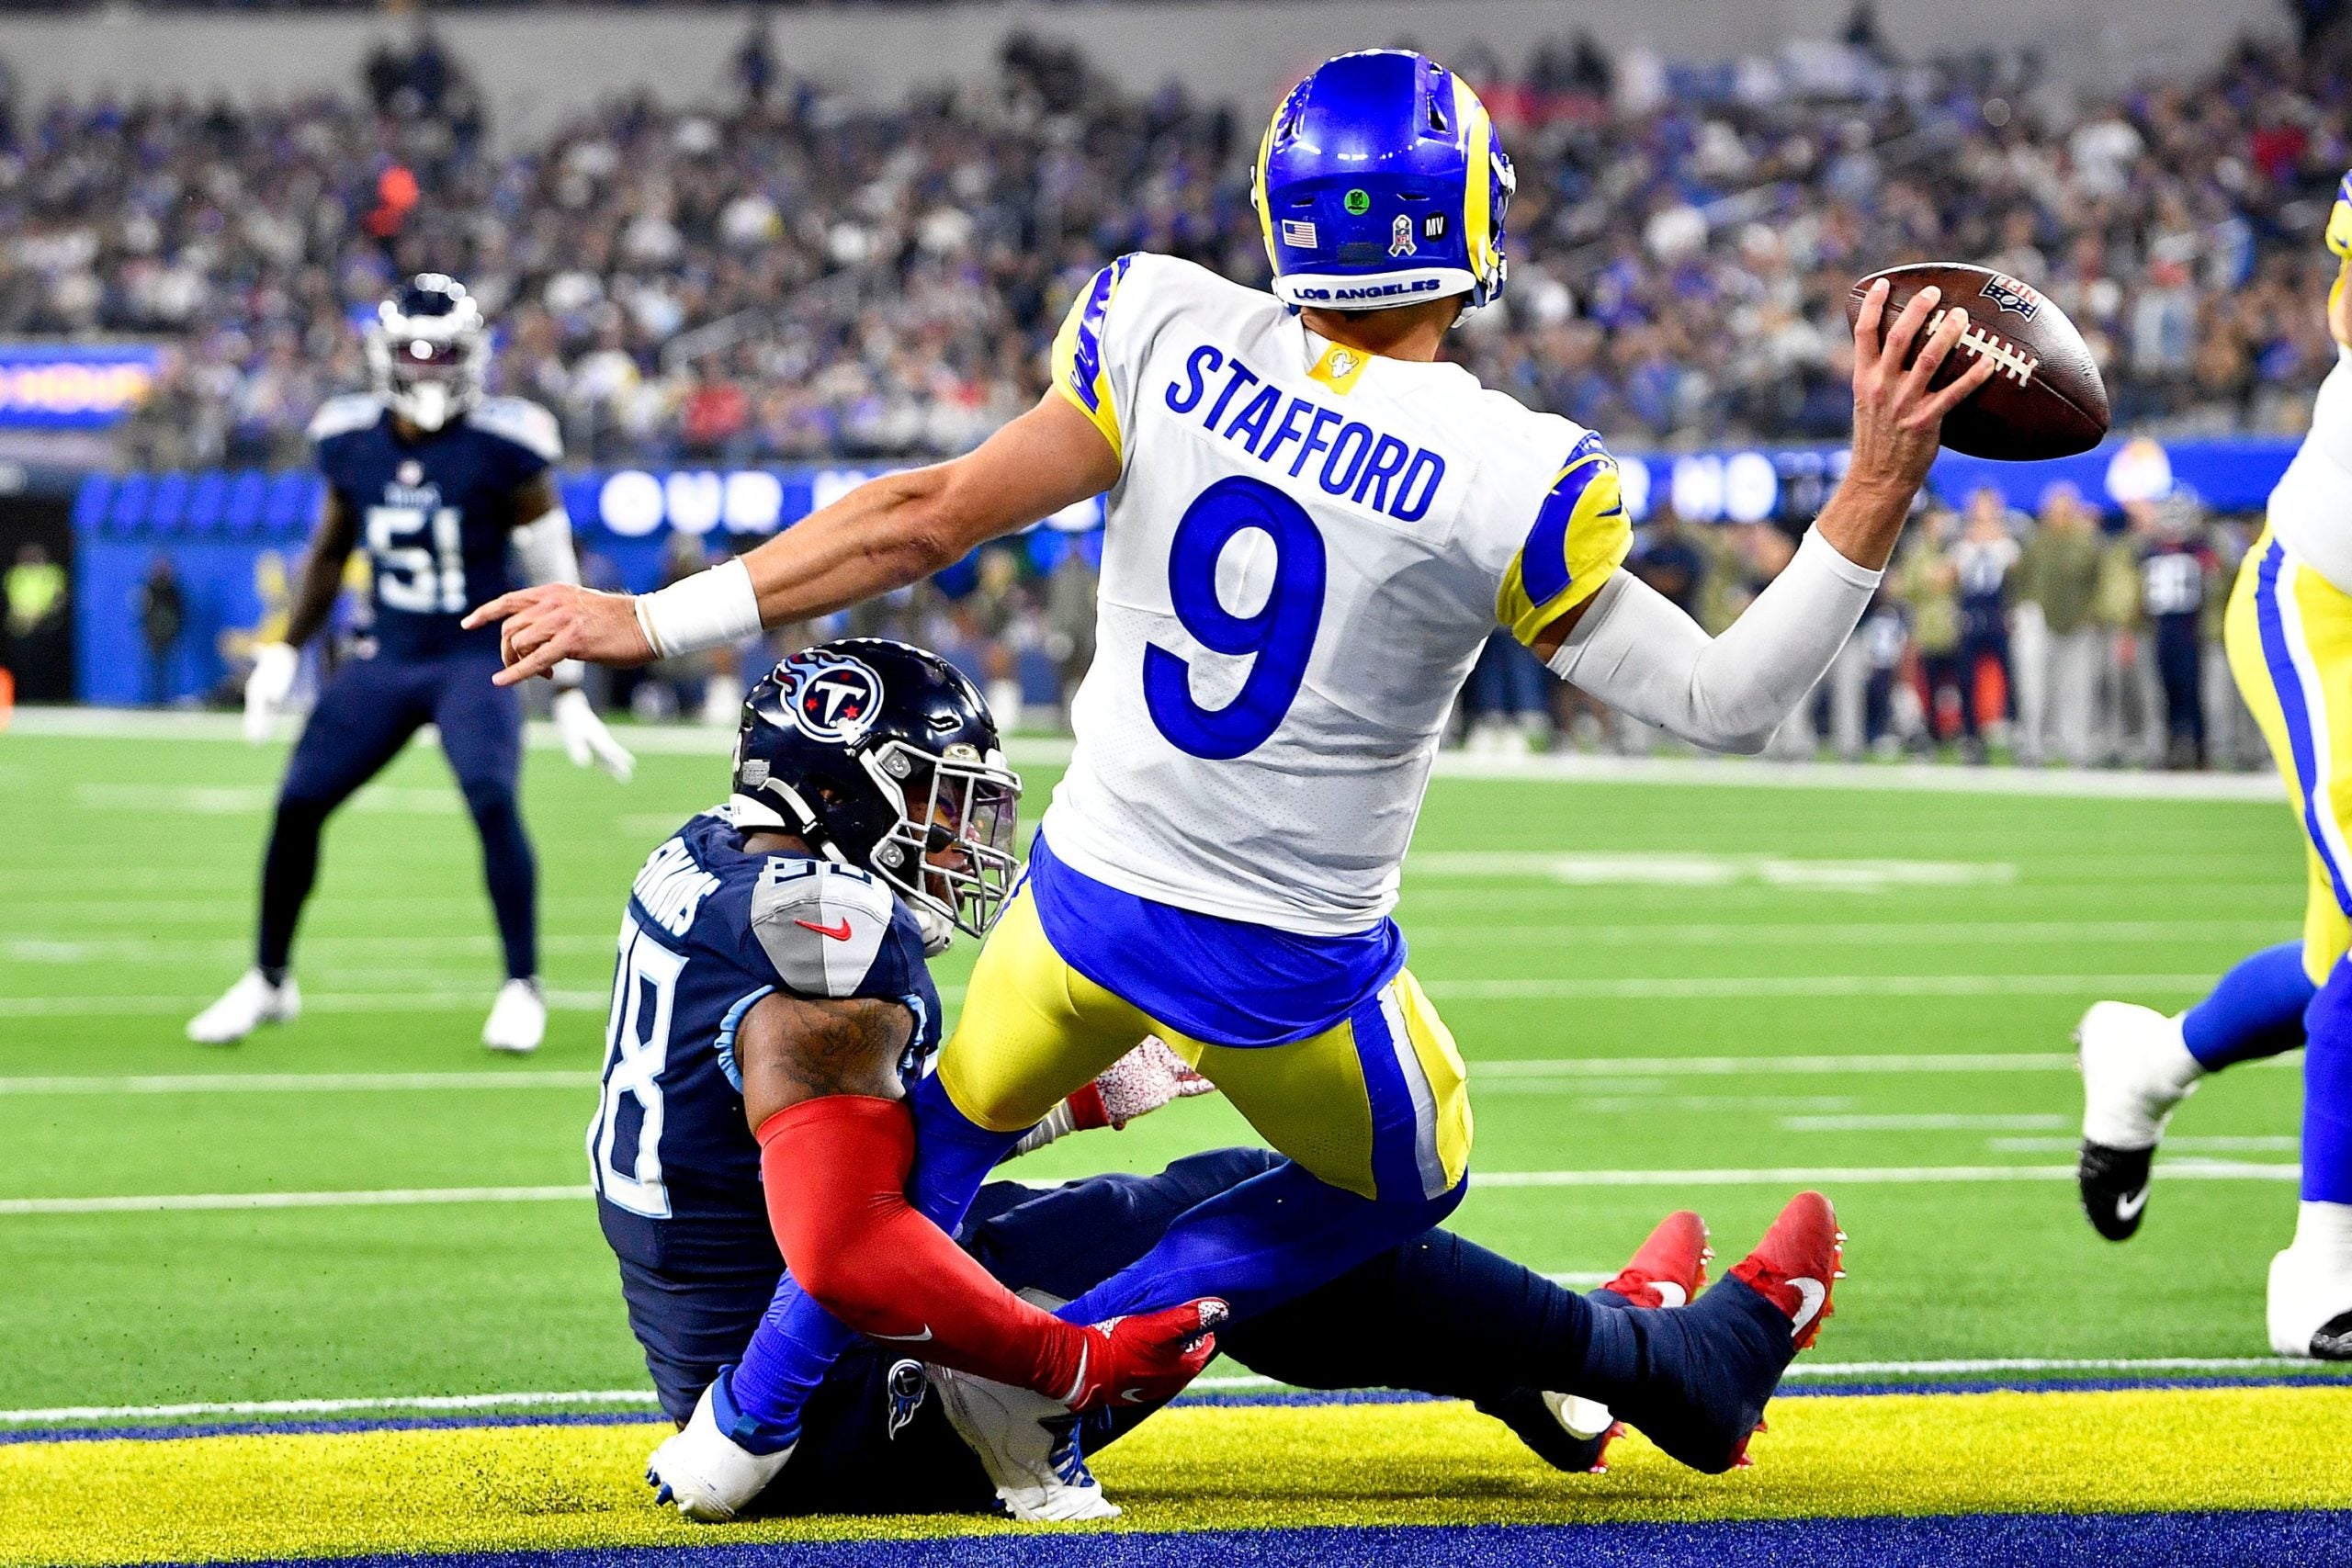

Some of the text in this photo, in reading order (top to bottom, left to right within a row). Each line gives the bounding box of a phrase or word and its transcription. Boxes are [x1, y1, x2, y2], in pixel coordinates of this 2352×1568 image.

[1426, 217, 1443, 236] MV
[1294, 279, 1441, 299] LOS ANGELES
[2000, 277, 2037, 304] NFL
[1165, 344, 1446, 523] STAFFORD
[368, 507, 467, 614] 51
[1143, 475, 1327, 761] 9
[815, 680, 867, 725] T
